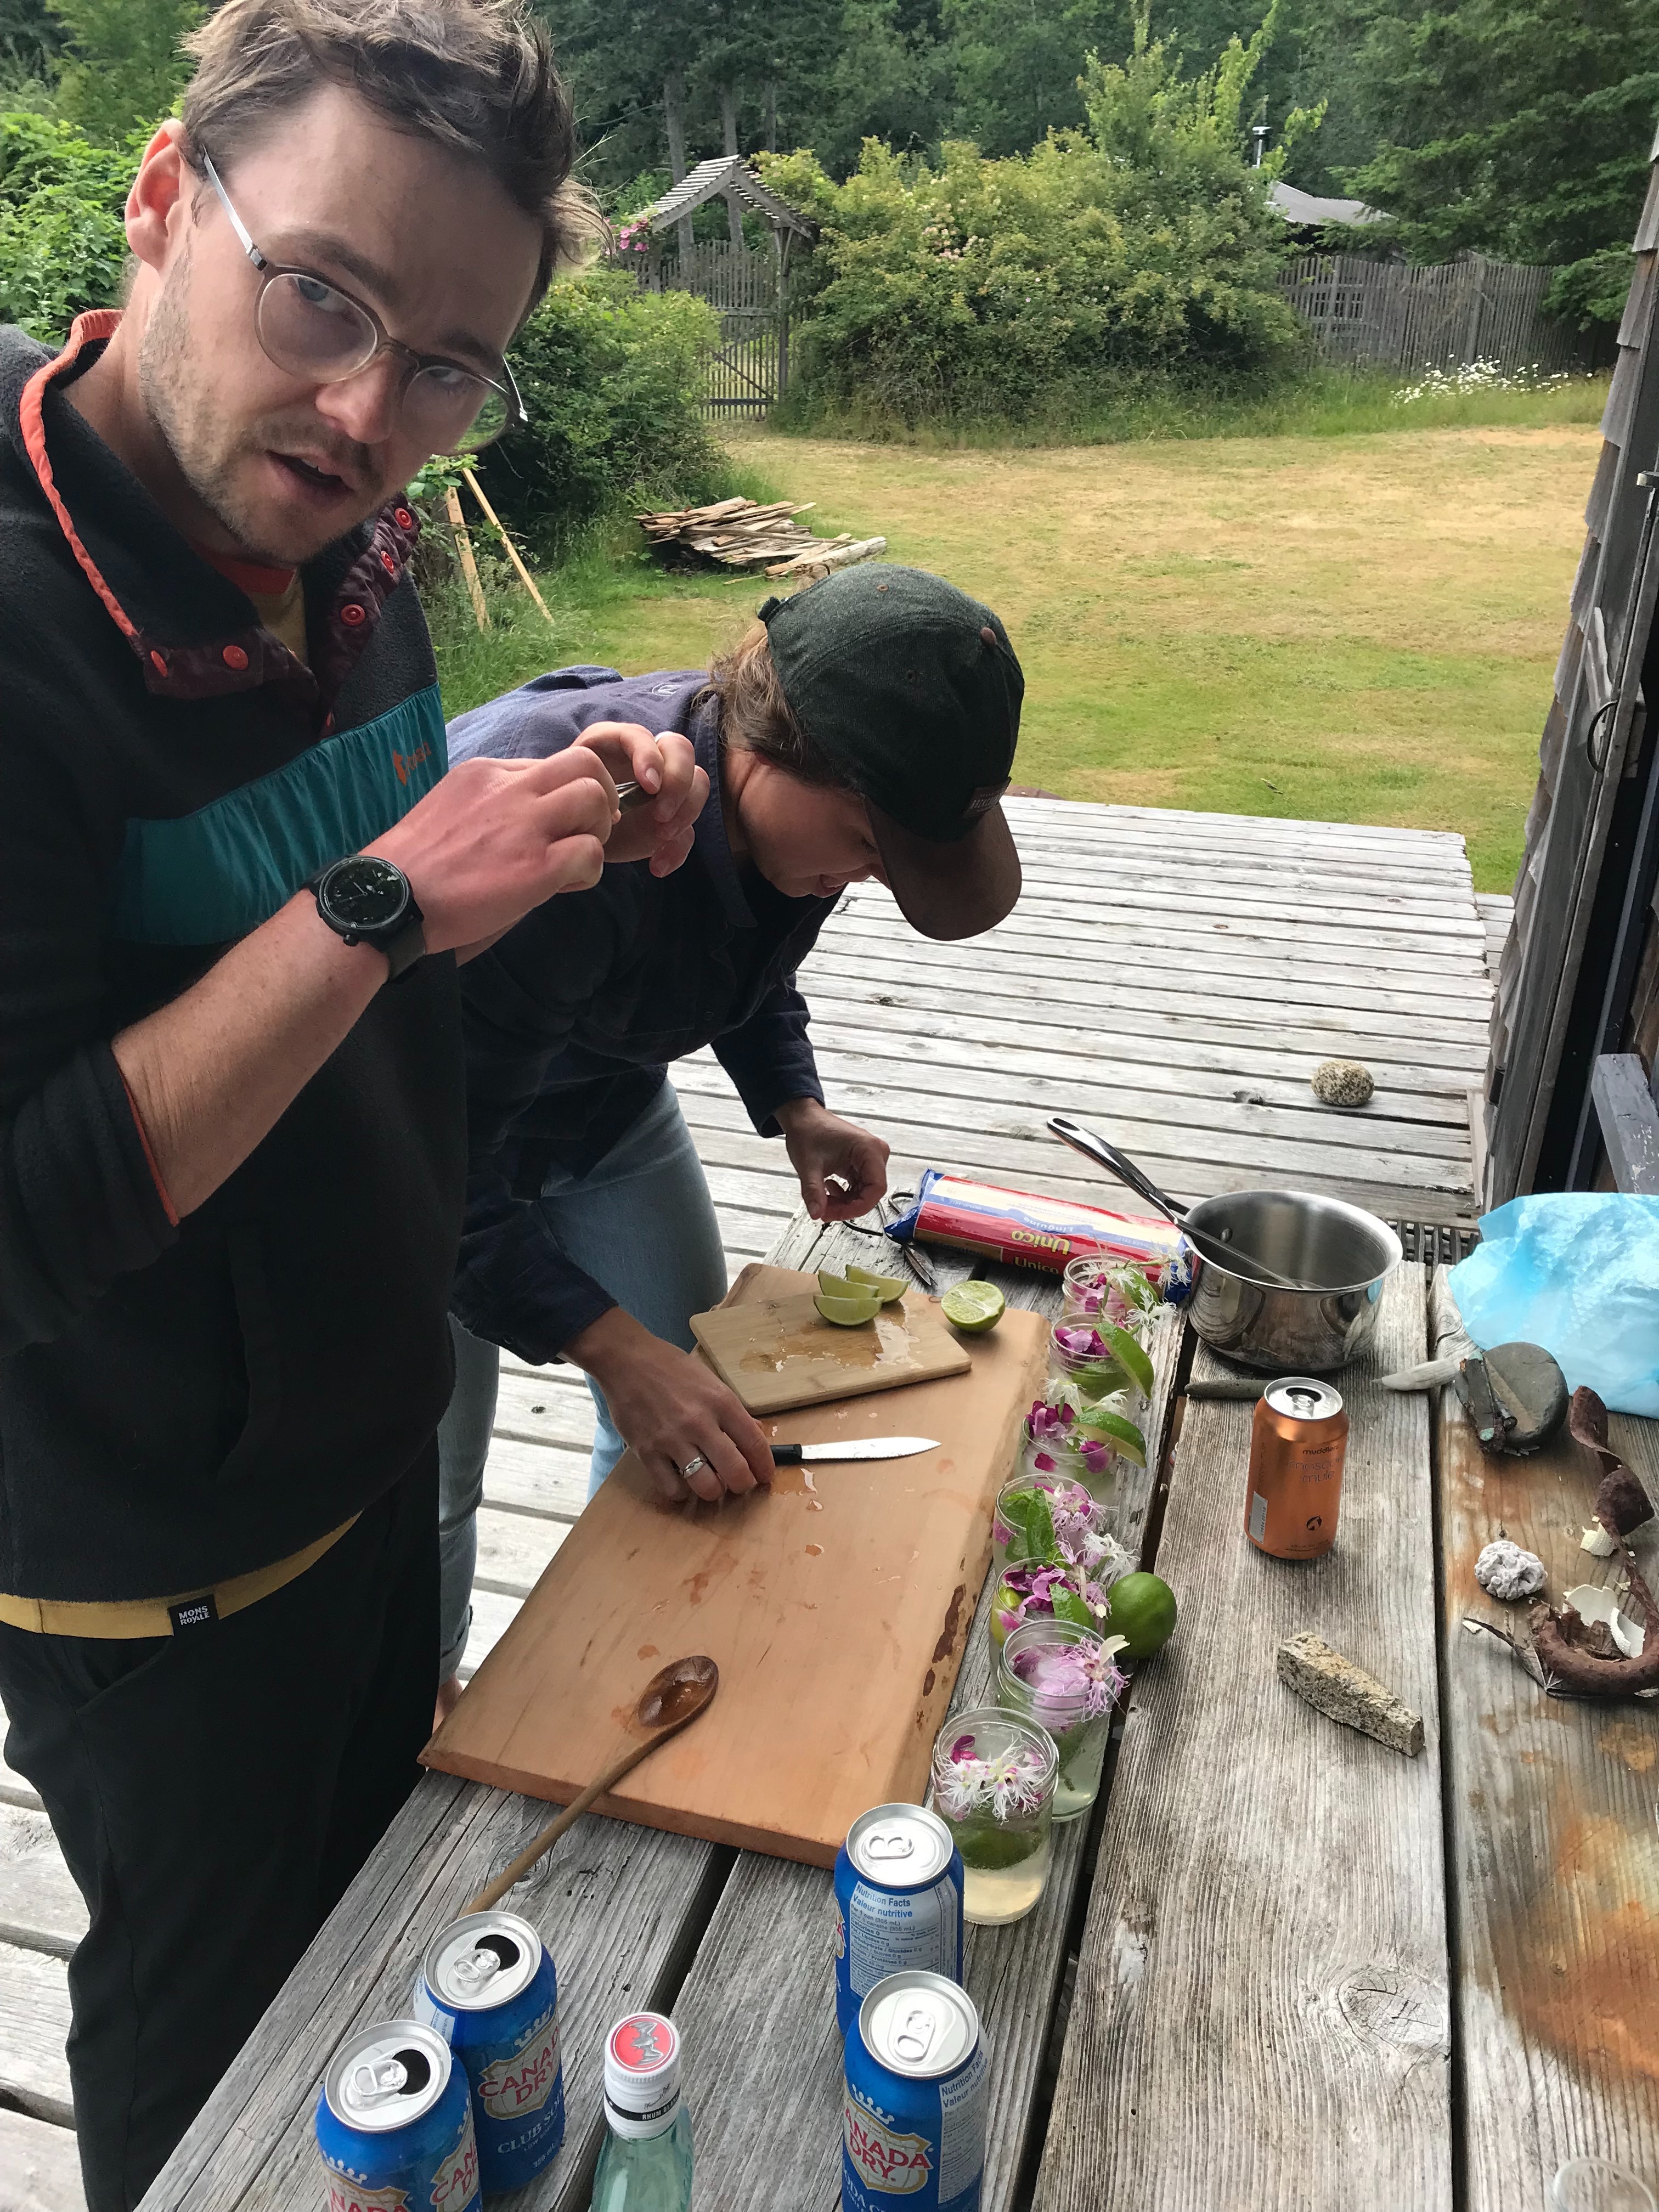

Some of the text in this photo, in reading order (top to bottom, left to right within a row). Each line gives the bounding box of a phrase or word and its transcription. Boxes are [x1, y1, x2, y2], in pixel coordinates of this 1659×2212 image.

[1023, 1217, 1074, 1232] Linguine
[1011, 1231, 1070, 1255] Unico
[1014, 1256, 1059, 1274] Unico
[1303, 1471, 1335, 1483] mule
[178, 1606, 208, 1619] MONS
[180, 1612, 210, 1626] ROYALE
[853, 1894, 913, 1918] Valeur nutritive
[856, 1884, 911, 1907] Nutrition Facts
[851, 1917, 874, 1934] Calories
[479, 2026, 558, 2097] CANAD
[515, 2061, 554, 2106] DRY
[941, 2071, 973, 2097] Nutrition
[972, 2050, 984, 2073] Facts
[943, 2089, 969, 2108] Valeur
[642, 2110, 661, 2120] RHUM
[498, 2123, 542, 2153] CLUB
[845, 2107, 931, 2169] ANADA
[850, 2131, 896, 2180] DRY
[432, 2142, 473, 2203] CAN
